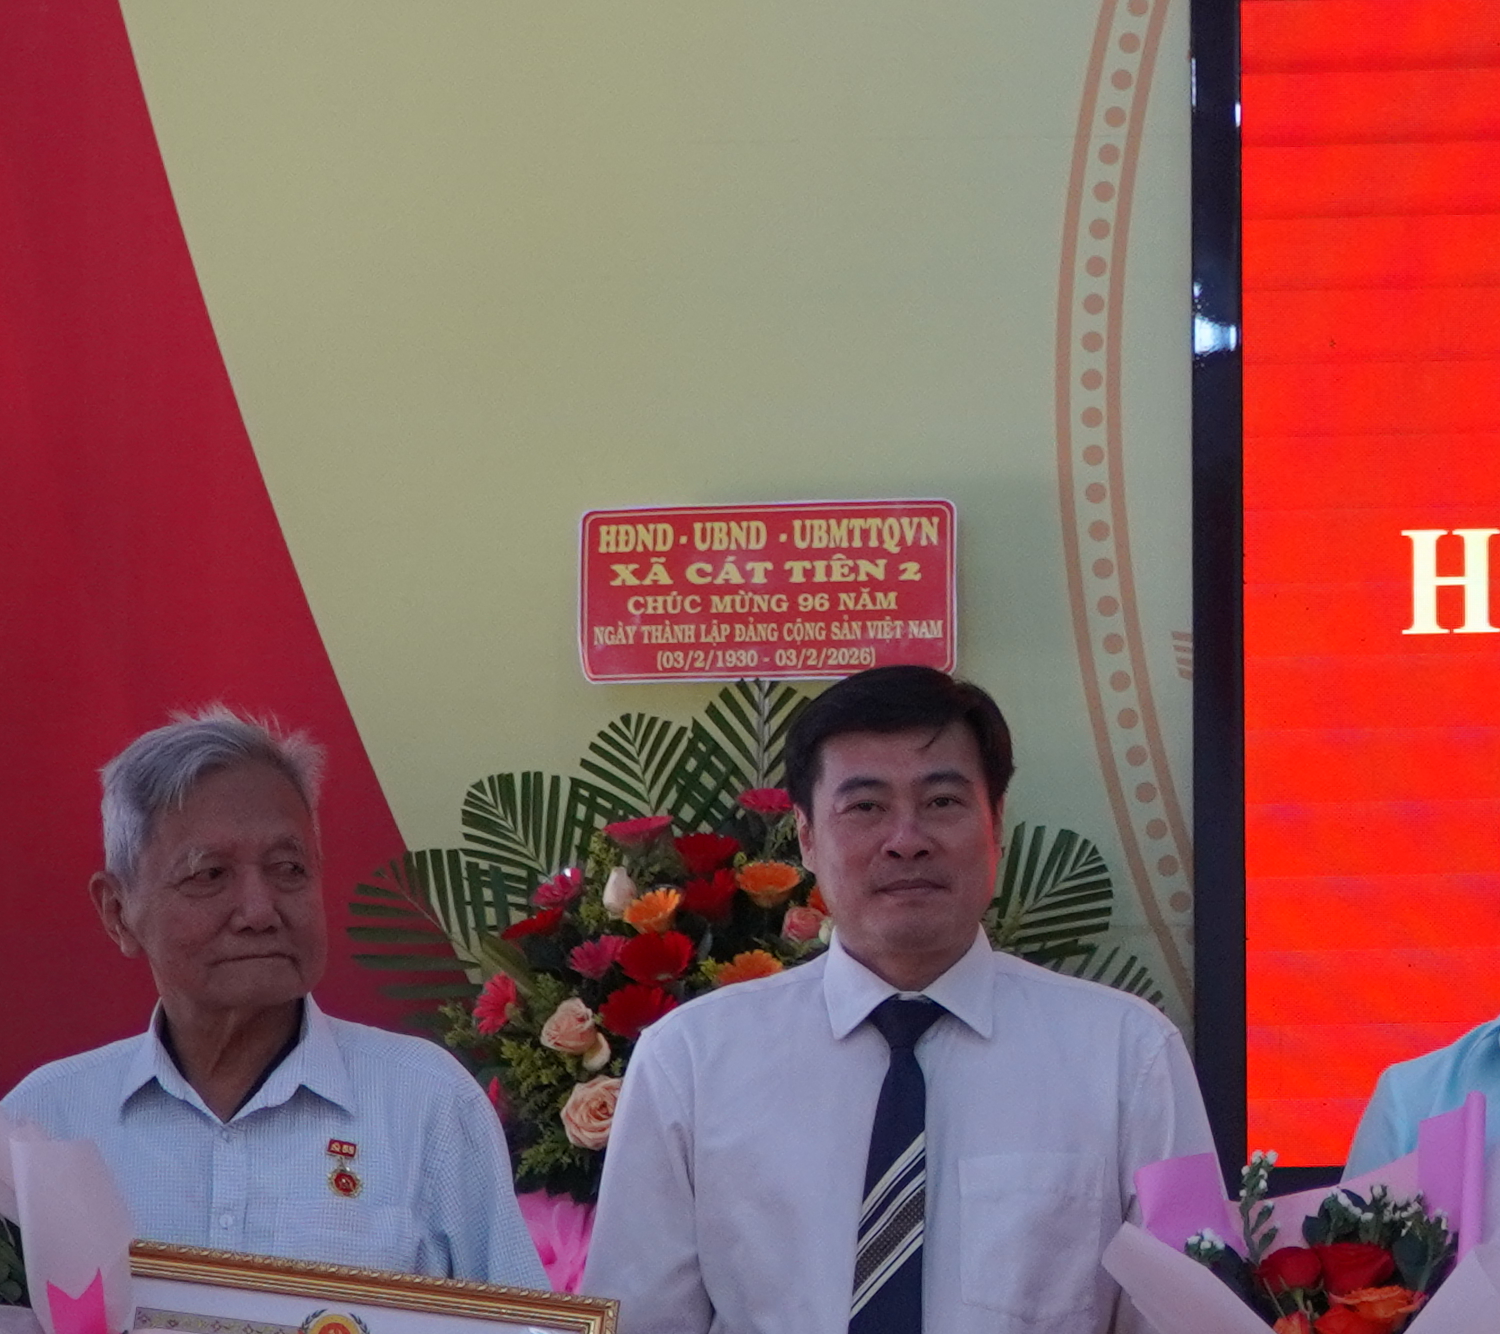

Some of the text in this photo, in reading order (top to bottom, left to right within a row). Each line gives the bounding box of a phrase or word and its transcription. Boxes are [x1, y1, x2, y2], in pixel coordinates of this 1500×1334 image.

[598, 522, 674, 553] HĐND
[693, 520, 767, 551] UBND
[793, 517, 940, 553] UBMTTQVN
[610, 554, 922, 586] XÃ CÁT TIÊN 2
[627, 587, 898, 614] CHÚC MỪNG 96 NĂM
[593, 615, 943, 646] NGÀY THÀNH LẬP ĐẢNG CỘNG SẢN VIỆT NAM
[657, 650, 758, 671] (03/2/1930
[775, 646, 876, 668] 03/2/2026)
